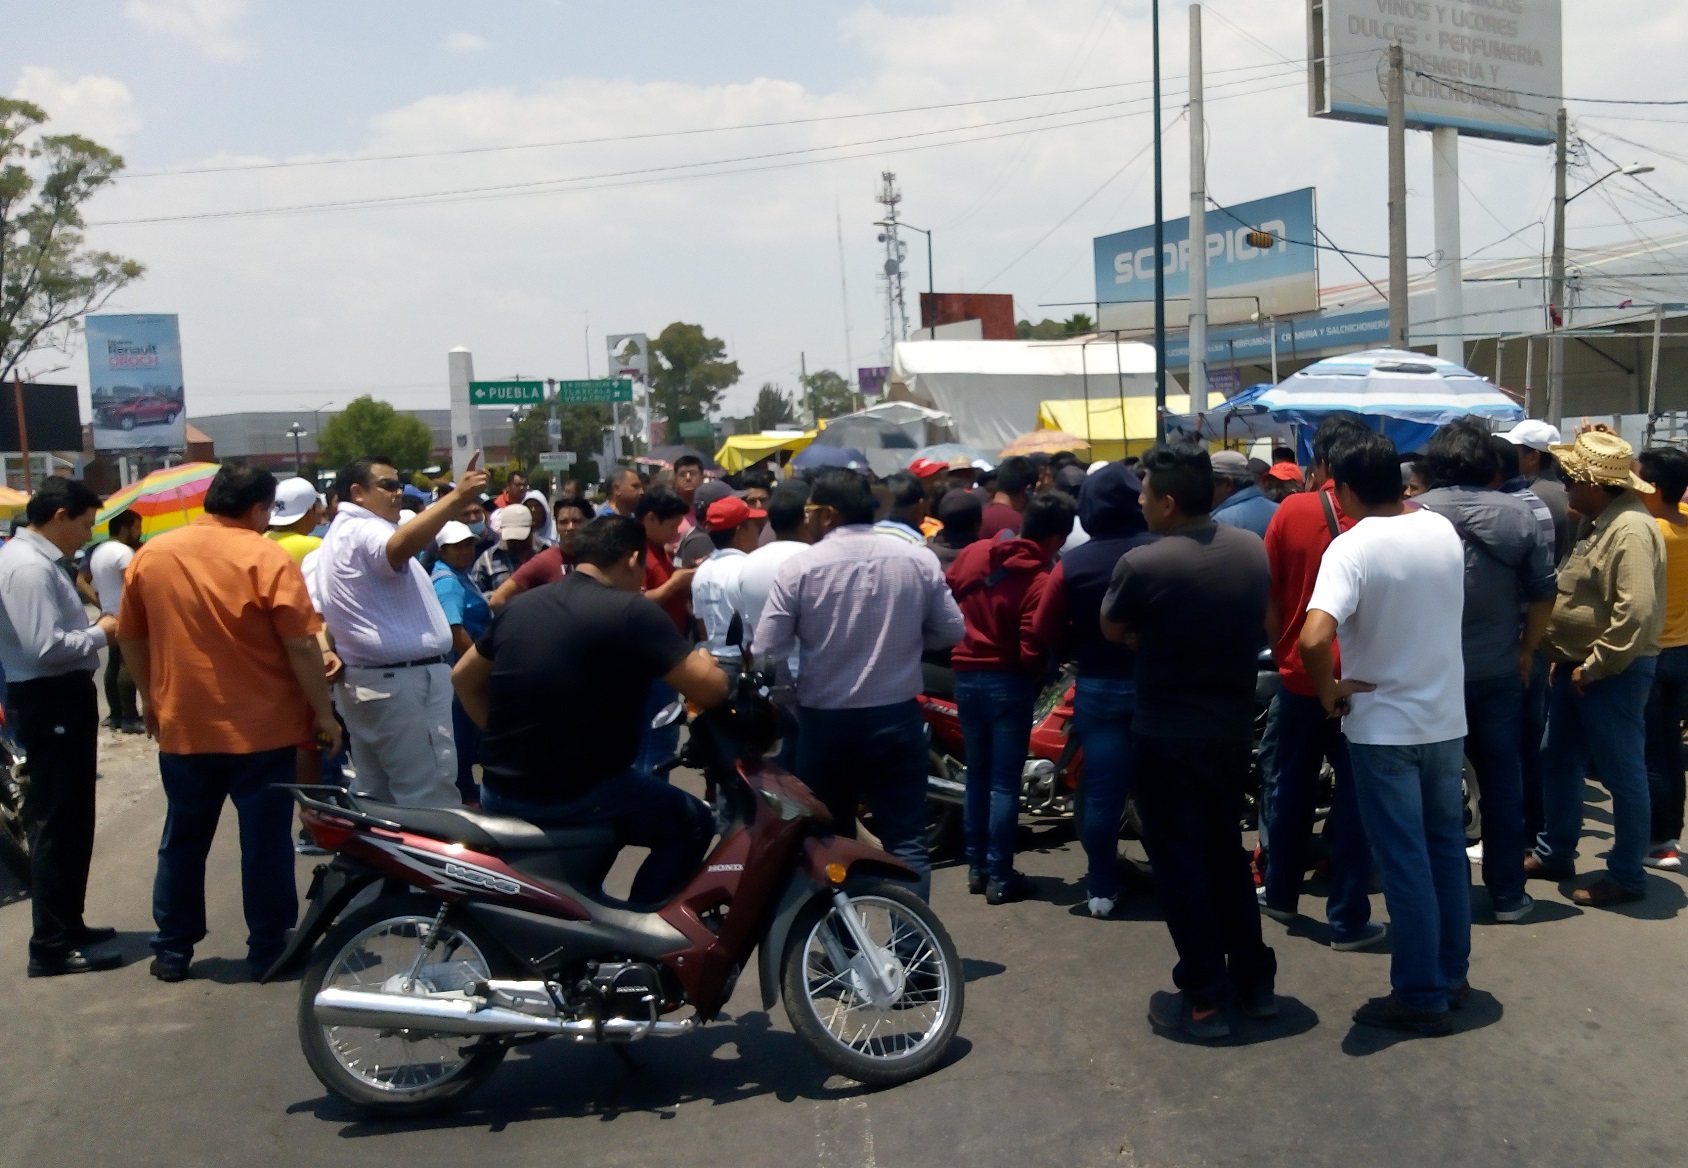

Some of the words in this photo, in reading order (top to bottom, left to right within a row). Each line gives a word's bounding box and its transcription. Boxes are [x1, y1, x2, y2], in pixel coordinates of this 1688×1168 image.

[1435, 4, 1447, 25] Y
[1348, 14, 1418, 44] DULCES
[1488, 63, 1500, 83] Y
[489, 387, 540, 399] PUEBLA
